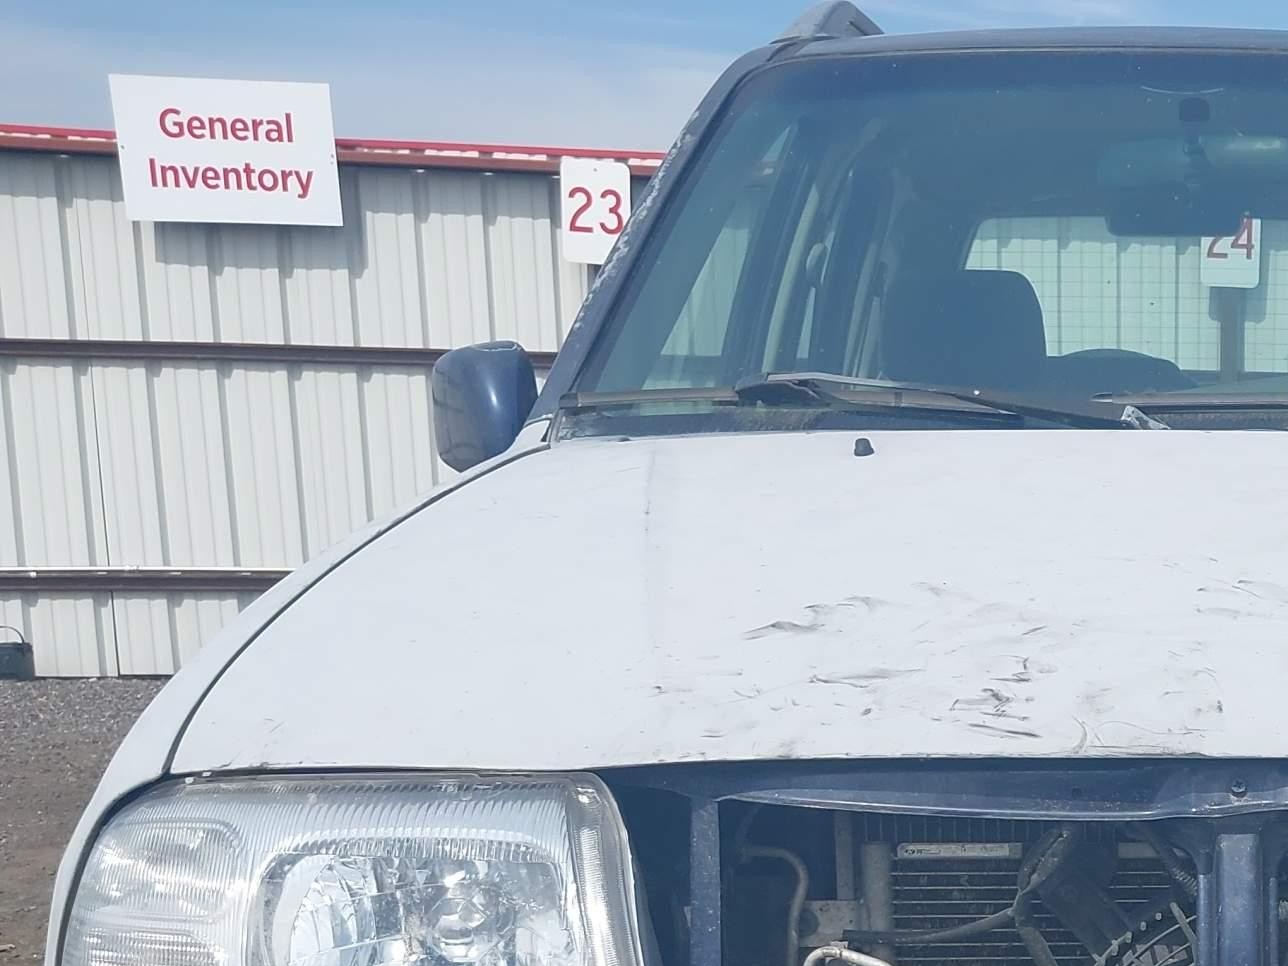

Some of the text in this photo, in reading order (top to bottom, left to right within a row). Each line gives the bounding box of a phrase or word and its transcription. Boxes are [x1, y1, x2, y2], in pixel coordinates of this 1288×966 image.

[158, 108, 294, 143] General
[148, 158, 313, 198] Inventory
[568, 186, 624, 235] 23
